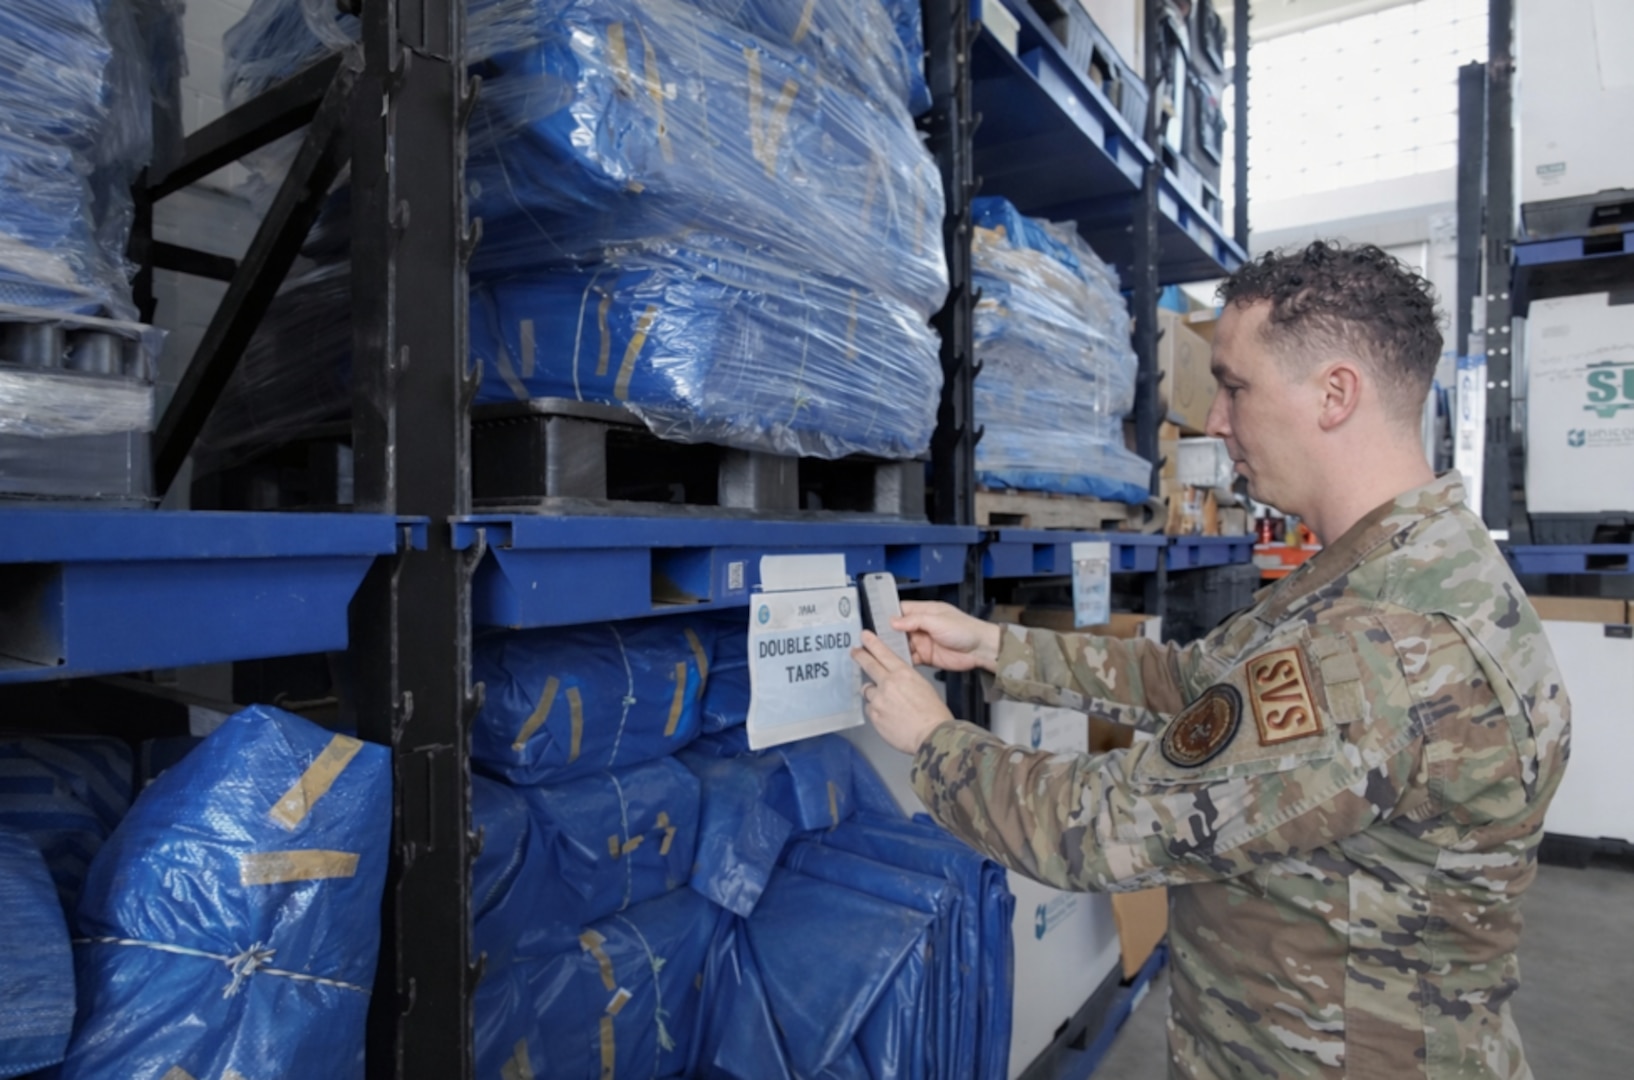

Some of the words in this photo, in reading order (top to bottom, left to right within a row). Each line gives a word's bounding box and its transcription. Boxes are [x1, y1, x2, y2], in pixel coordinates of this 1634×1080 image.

[759, 636, 812, 659] DOUBLE
[815, 632, 851, 651] SIDED
[786, 661, 829, 683] TARPS
[1256, 659, 1308, 730] SVS
